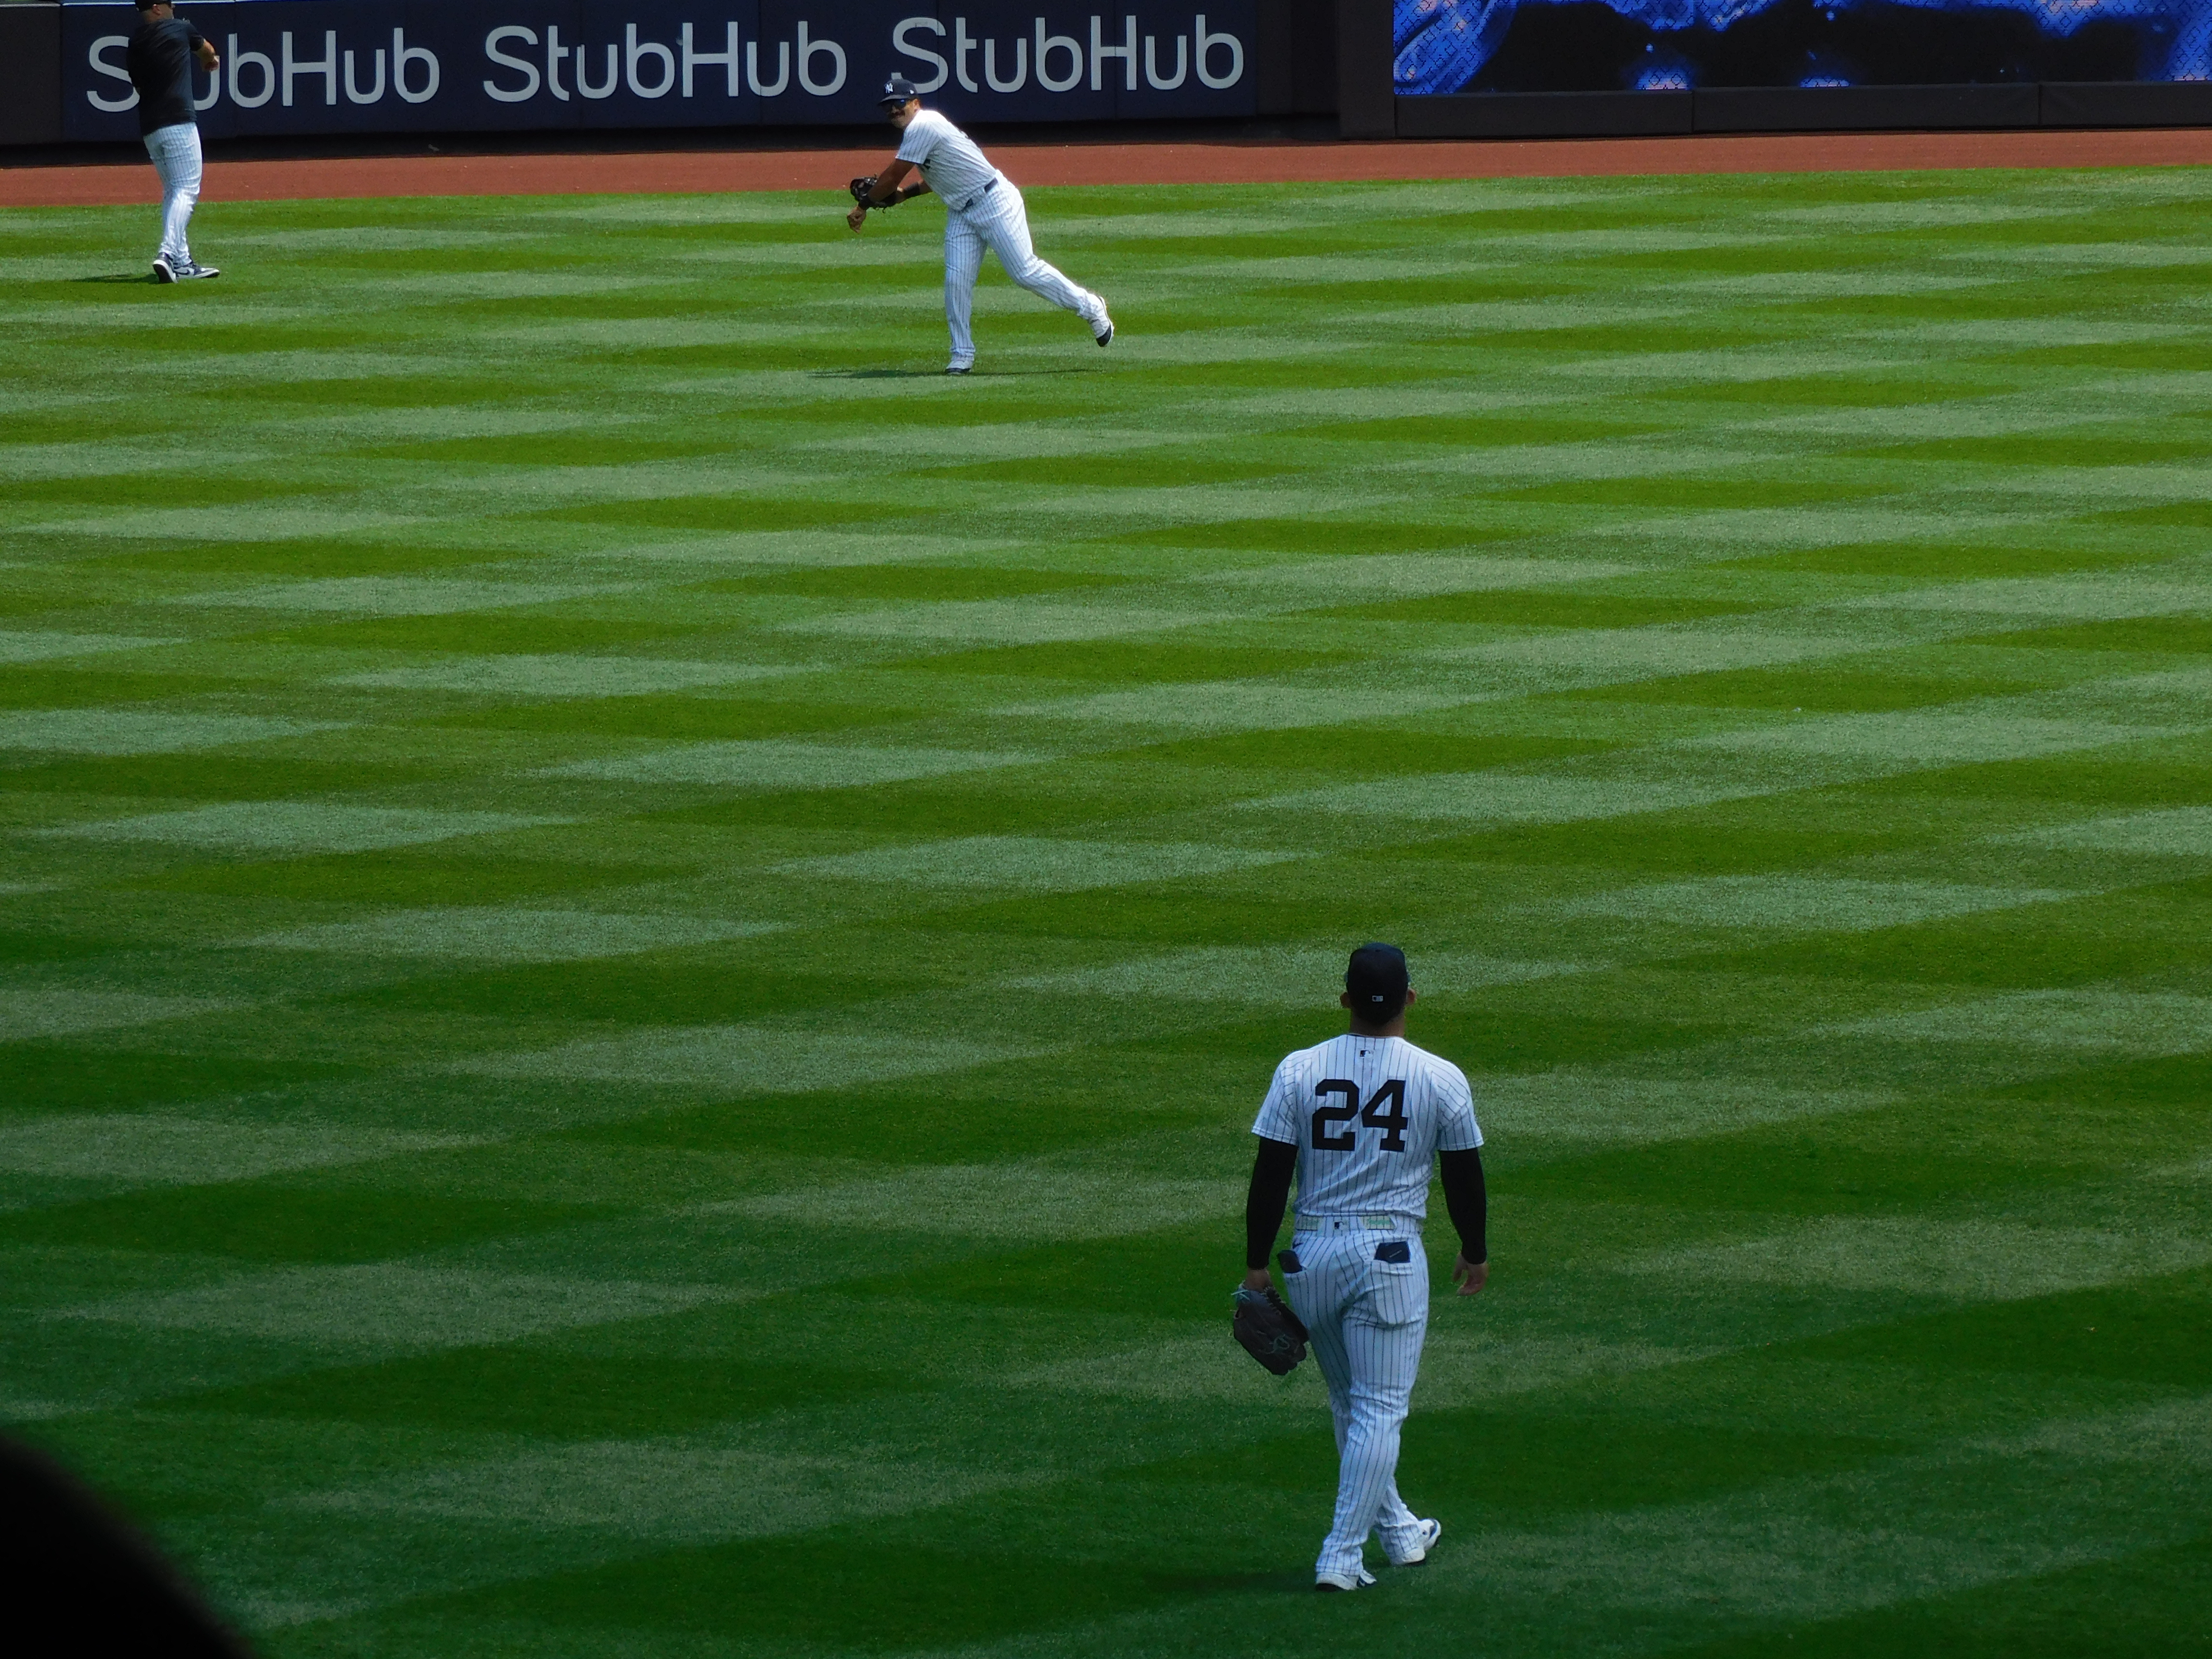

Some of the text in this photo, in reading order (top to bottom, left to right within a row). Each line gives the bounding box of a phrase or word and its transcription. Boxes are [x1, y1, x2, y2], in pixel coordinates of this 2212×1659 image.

[87, 14, 1244, 112] SbHub StubHub StubHub
[1311, 1079, 1409, 1153] 24
